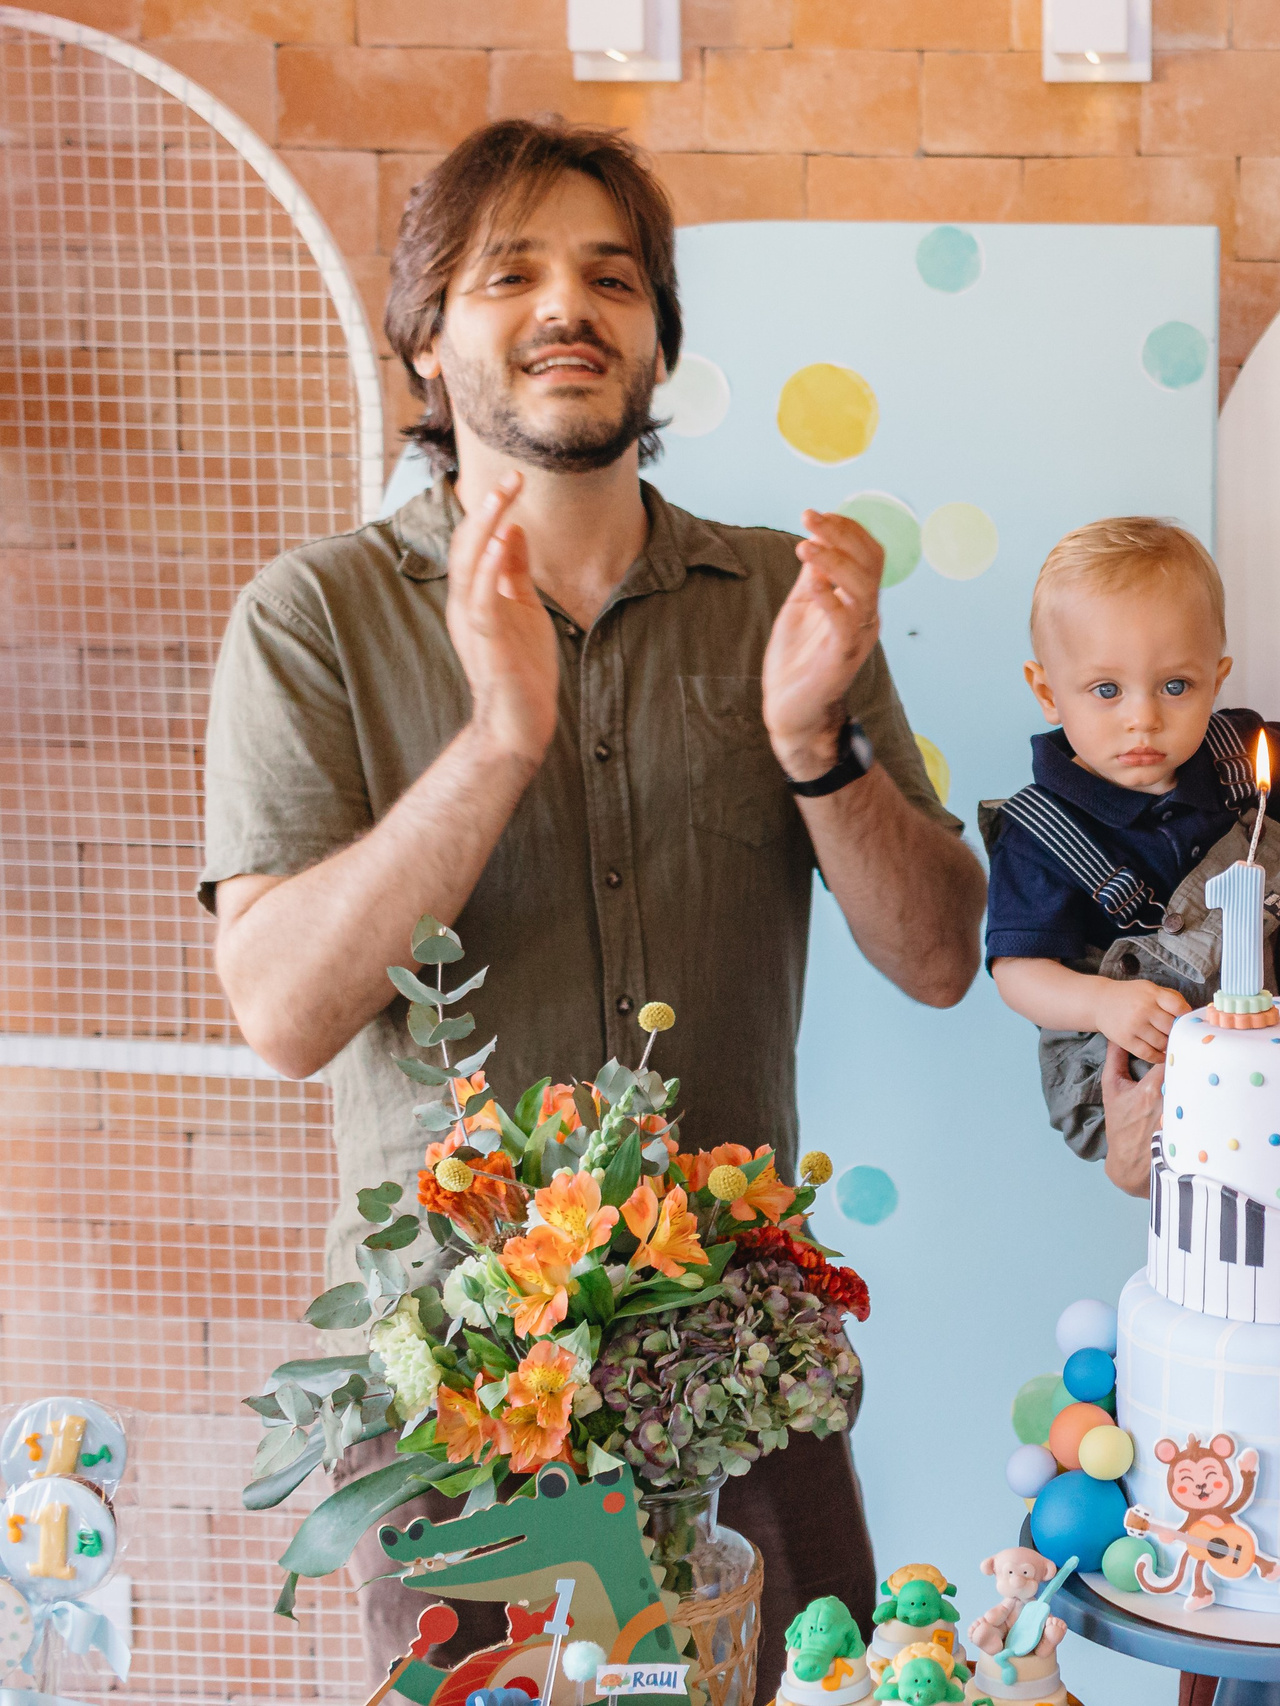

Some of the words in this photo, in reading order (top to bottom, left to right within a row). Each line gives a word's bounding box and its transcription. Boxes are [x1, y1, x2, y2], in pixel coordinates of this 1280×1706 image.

[1205, 860, 1266, 996] 1
[29, 1503, 77, 1580] 1
[544, 1579, 576, 1636] 1
